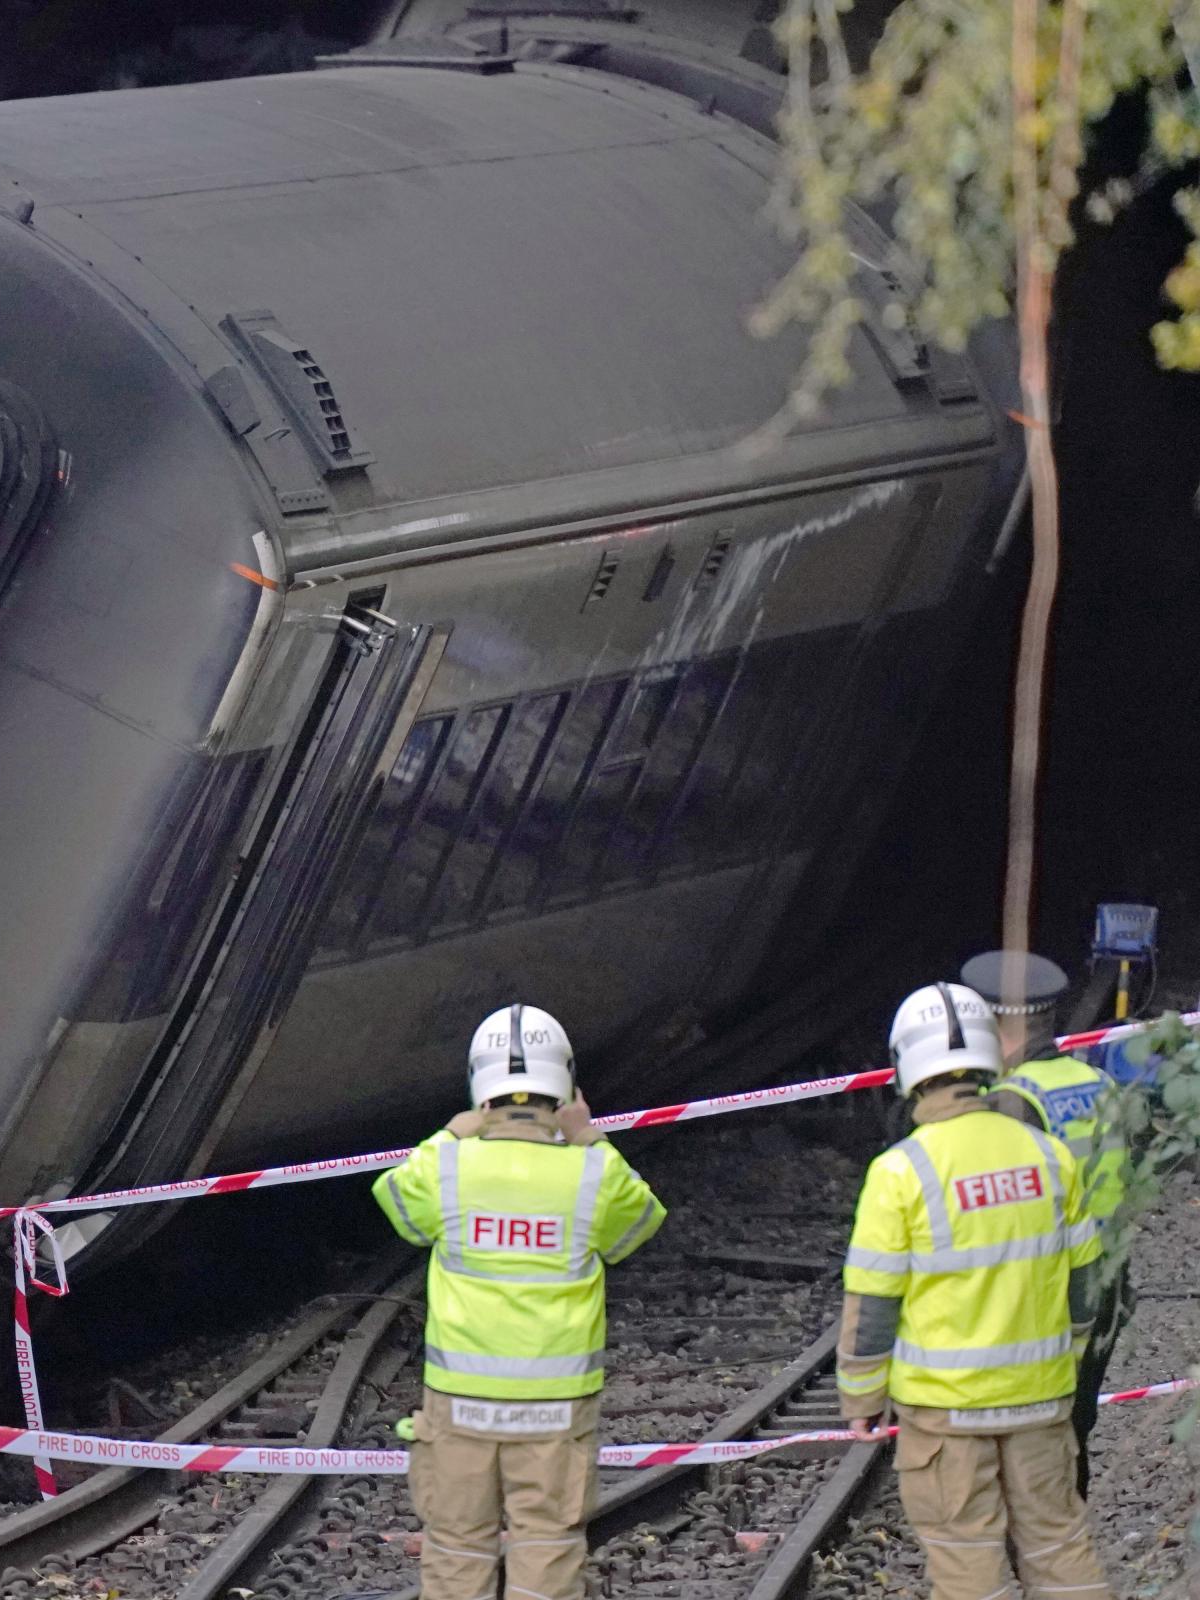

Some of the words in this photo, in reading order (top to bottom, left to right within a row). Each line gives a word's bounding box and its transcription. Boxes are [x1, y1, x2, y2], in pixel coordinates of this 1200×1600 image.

[524, 1030, 552, 1045] 001
[965, 1168, 1038, 1208] FIRE
[473, 1216, 557, 1248] FIRE
[16, 1340, 30, 1367] FIRE
[38, 1434, 69, 1452] FIRE
[73, 1439, 93, 1454] DO
[98, 1442, 126, 1457] NOT
[131, 1444, 180, 1462] CROSS
[258, 1451, 290, 1465] FIRE
[295, 1452, 316, 1467] DO
[320, 1452, 348, 1466] NOT
[354, 1452, 404, 1466] CROSS
[713, 1445, 746, 1456] FIRE
